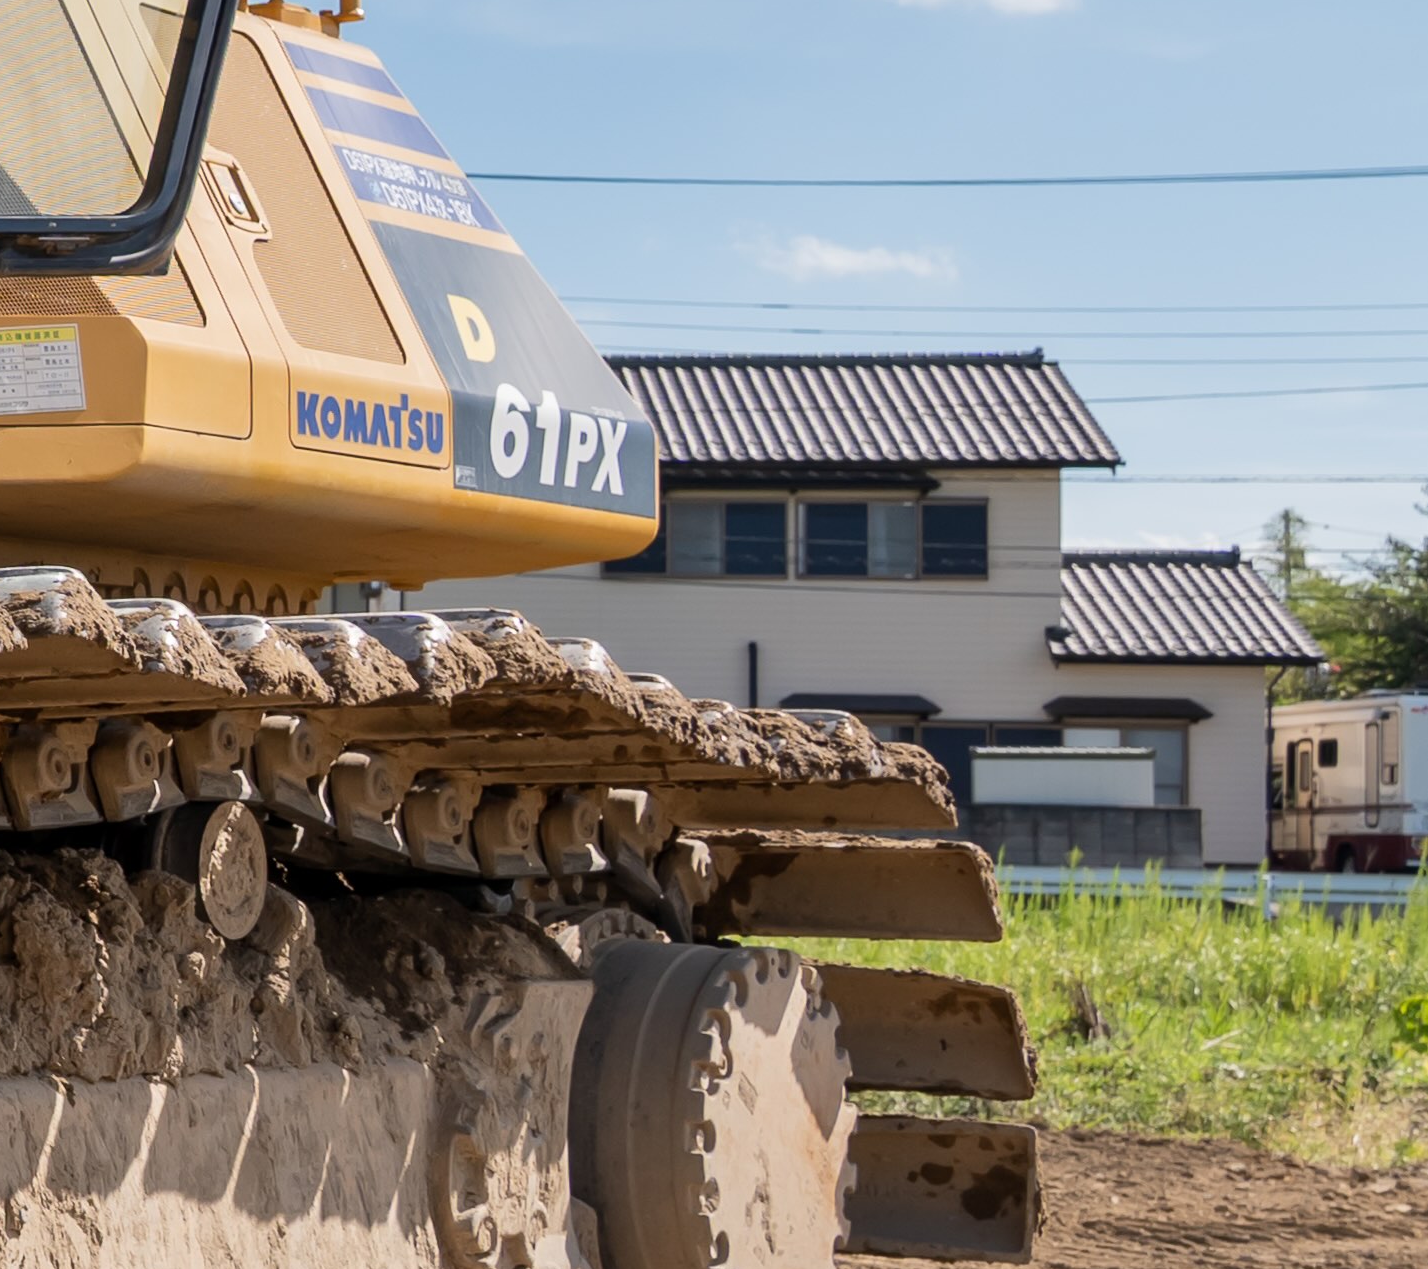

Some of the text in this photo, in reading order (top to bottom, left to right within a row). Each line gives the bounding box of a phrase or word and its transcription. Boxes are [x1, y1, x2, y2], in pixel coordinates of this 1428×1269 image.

[447, 294, 496, 363] D
[296, 390, 443, 454] KOMATSU
[490, 382, 628, 496] 61PX
